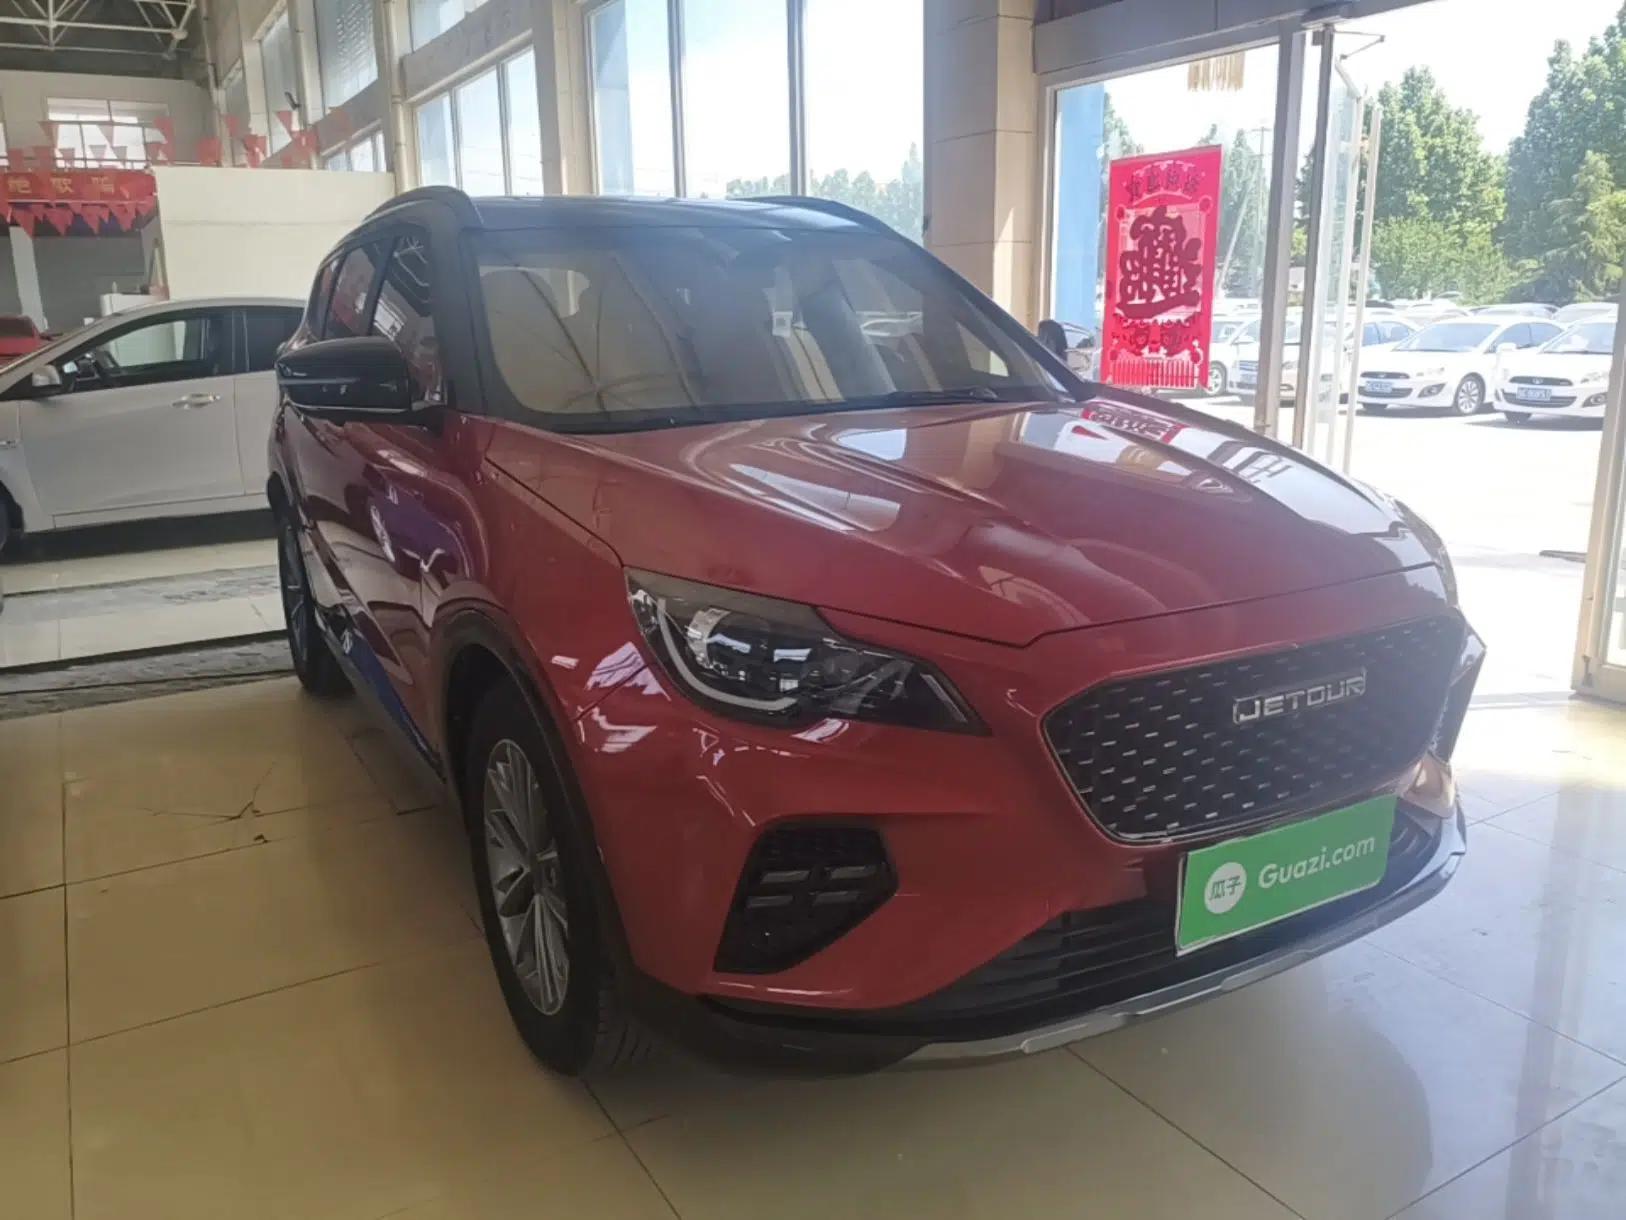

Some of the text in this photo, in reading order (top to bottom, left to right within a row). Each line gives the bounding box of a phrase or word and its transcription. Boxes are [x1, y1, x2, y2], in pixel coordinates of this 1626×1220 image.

[1236, 673, 1366, 723] JETOUR
[1208, 874, 1243, 900] 瓜子
[1257, 836, 1376, 889] Guazi.com
